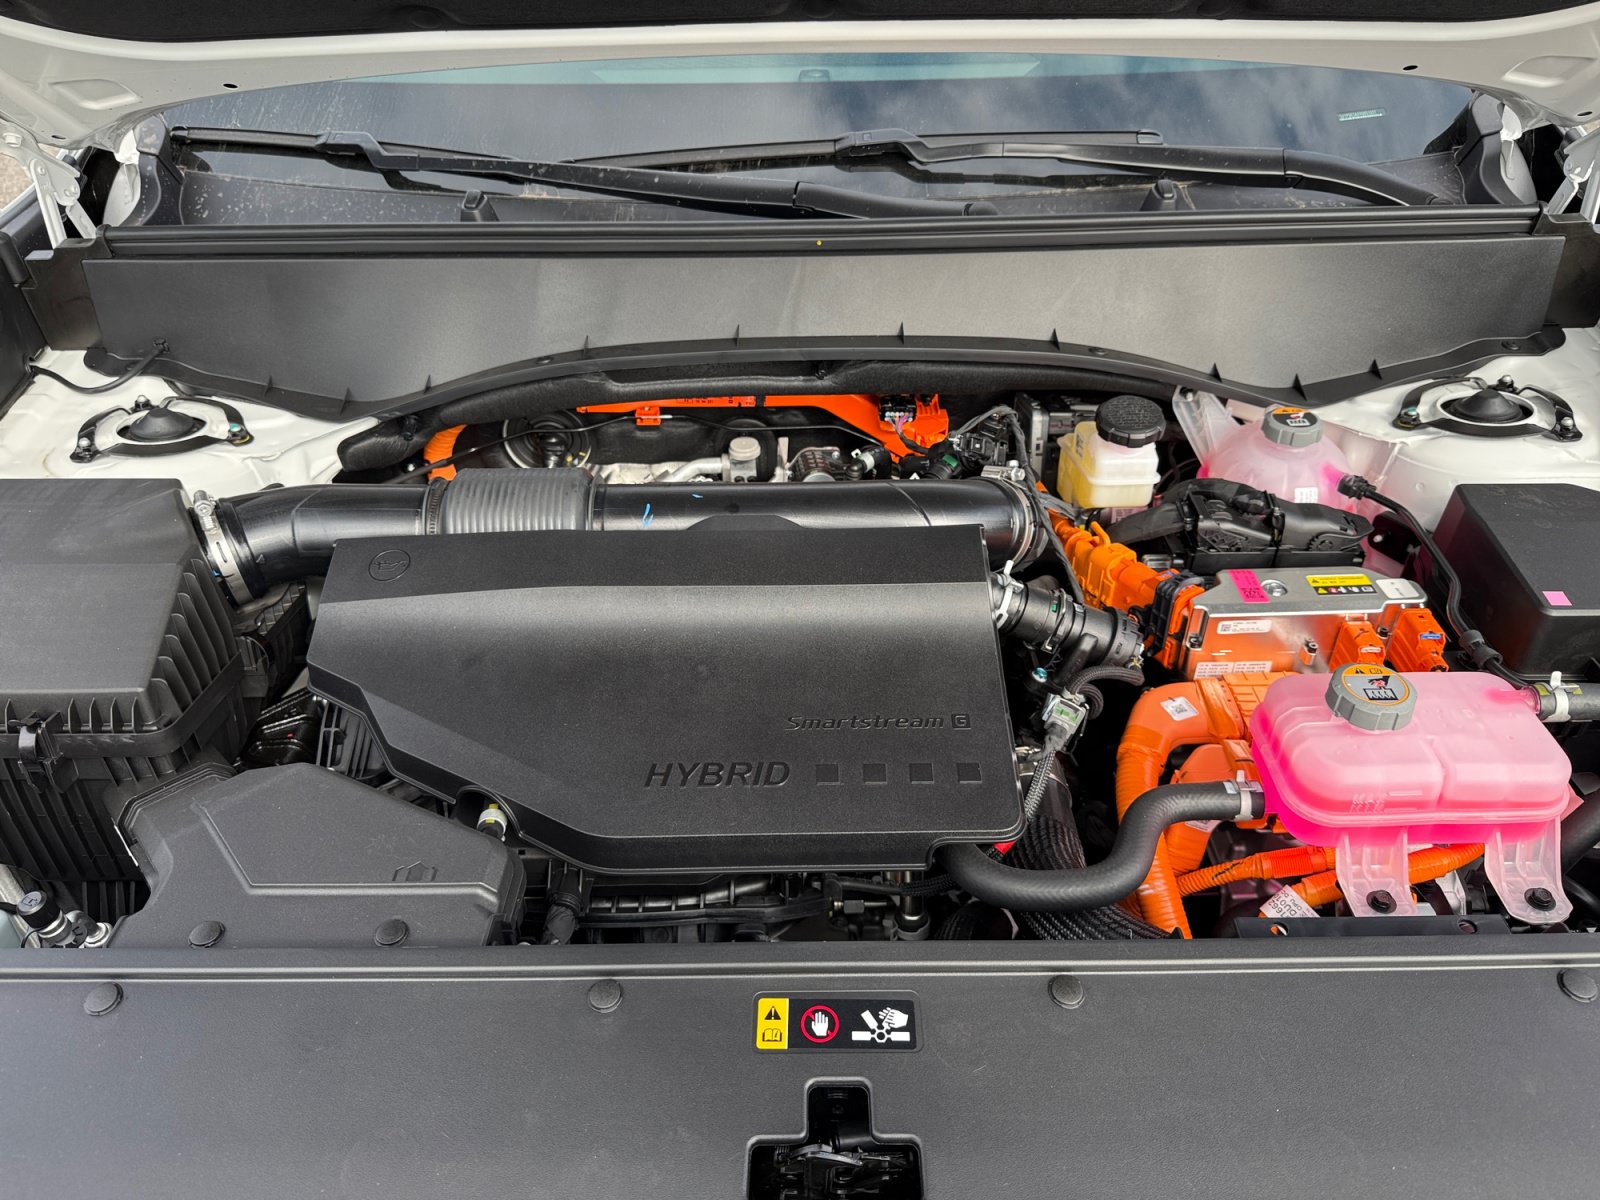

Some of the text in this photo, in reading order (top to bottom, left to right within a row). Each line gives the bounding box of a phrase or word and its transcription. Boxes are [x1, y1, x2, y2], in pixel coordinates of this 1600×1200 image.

[785, 714, 969, 730] Smartstream G
[644, 762, 790, 787] HYBRID
